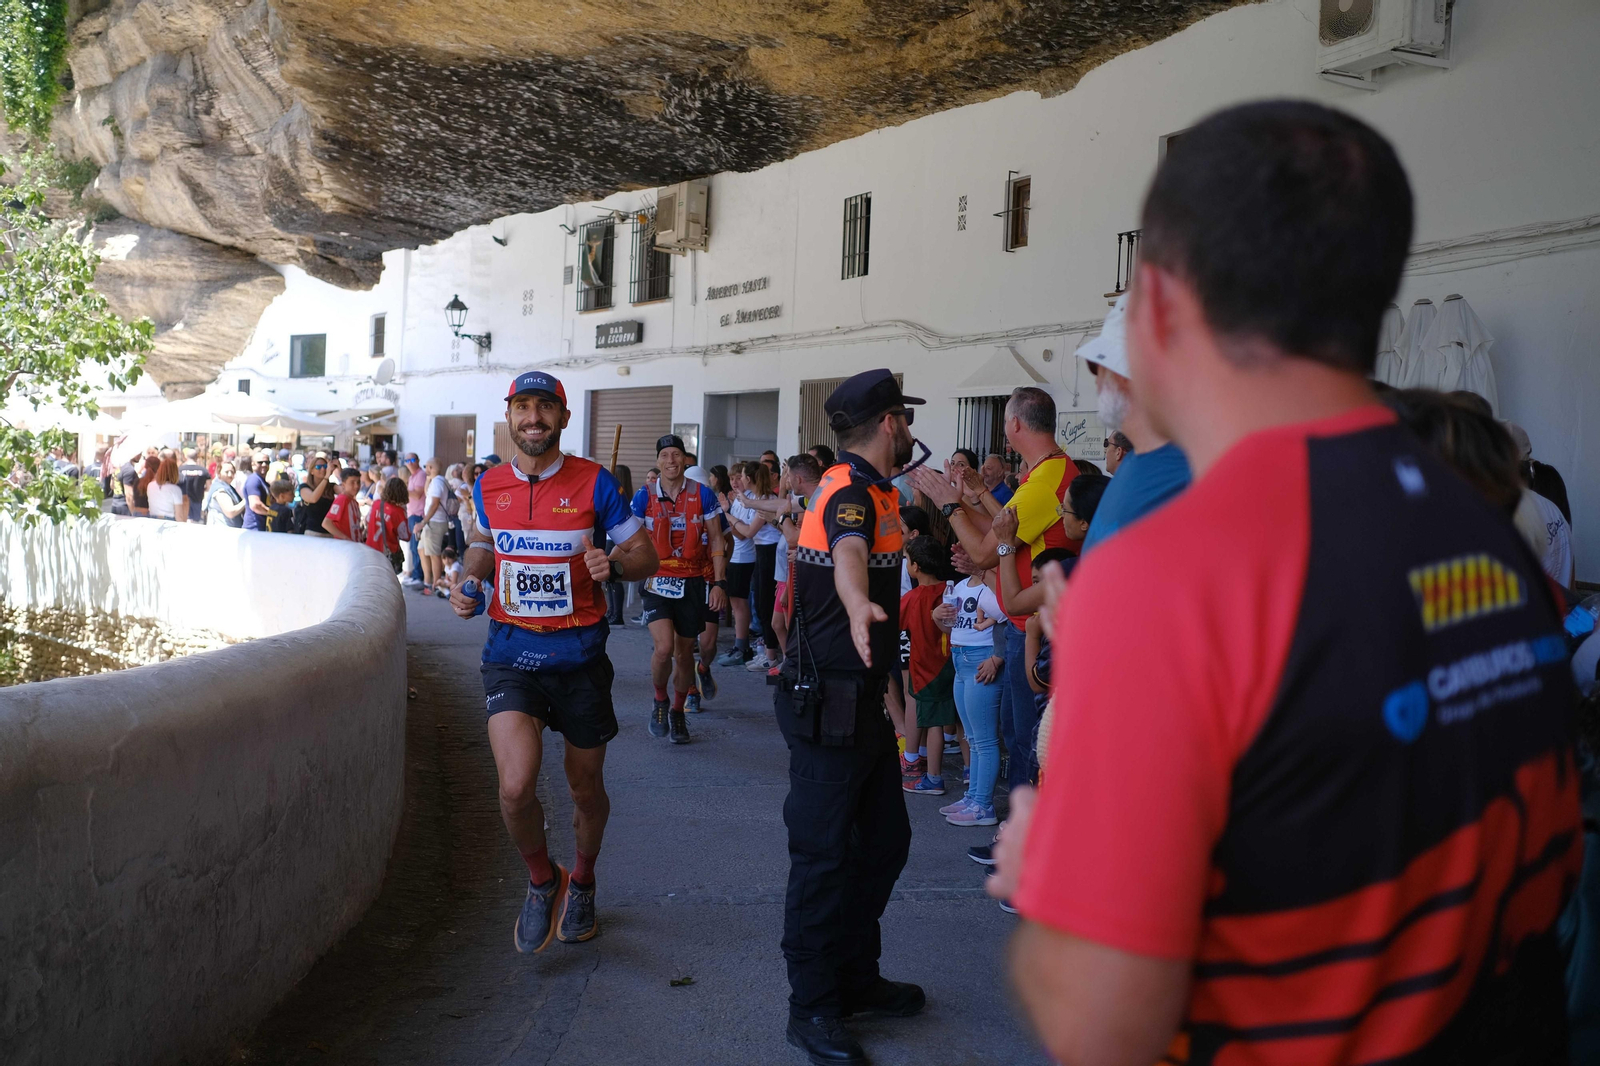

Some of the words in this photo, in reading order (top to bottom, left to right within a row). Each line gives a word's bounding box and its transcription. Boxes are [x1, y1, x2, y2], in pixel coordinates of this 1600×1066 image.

[609, 326, 623, 334] BAR
[598, 335, 606, 345] LA
[607, 332, 635, 343] ESCUEVA
[1061, 419, 1086, 444] Luque
[515, 536, 573, 552] Avanza
[516, 573, 566, 593] 8881
[656, 576, 683, 589] 8885
[516, 656, 542, 667] RESS
[522, 650, 548, 660] COMP
[512, 662, 539, 672] PORT
